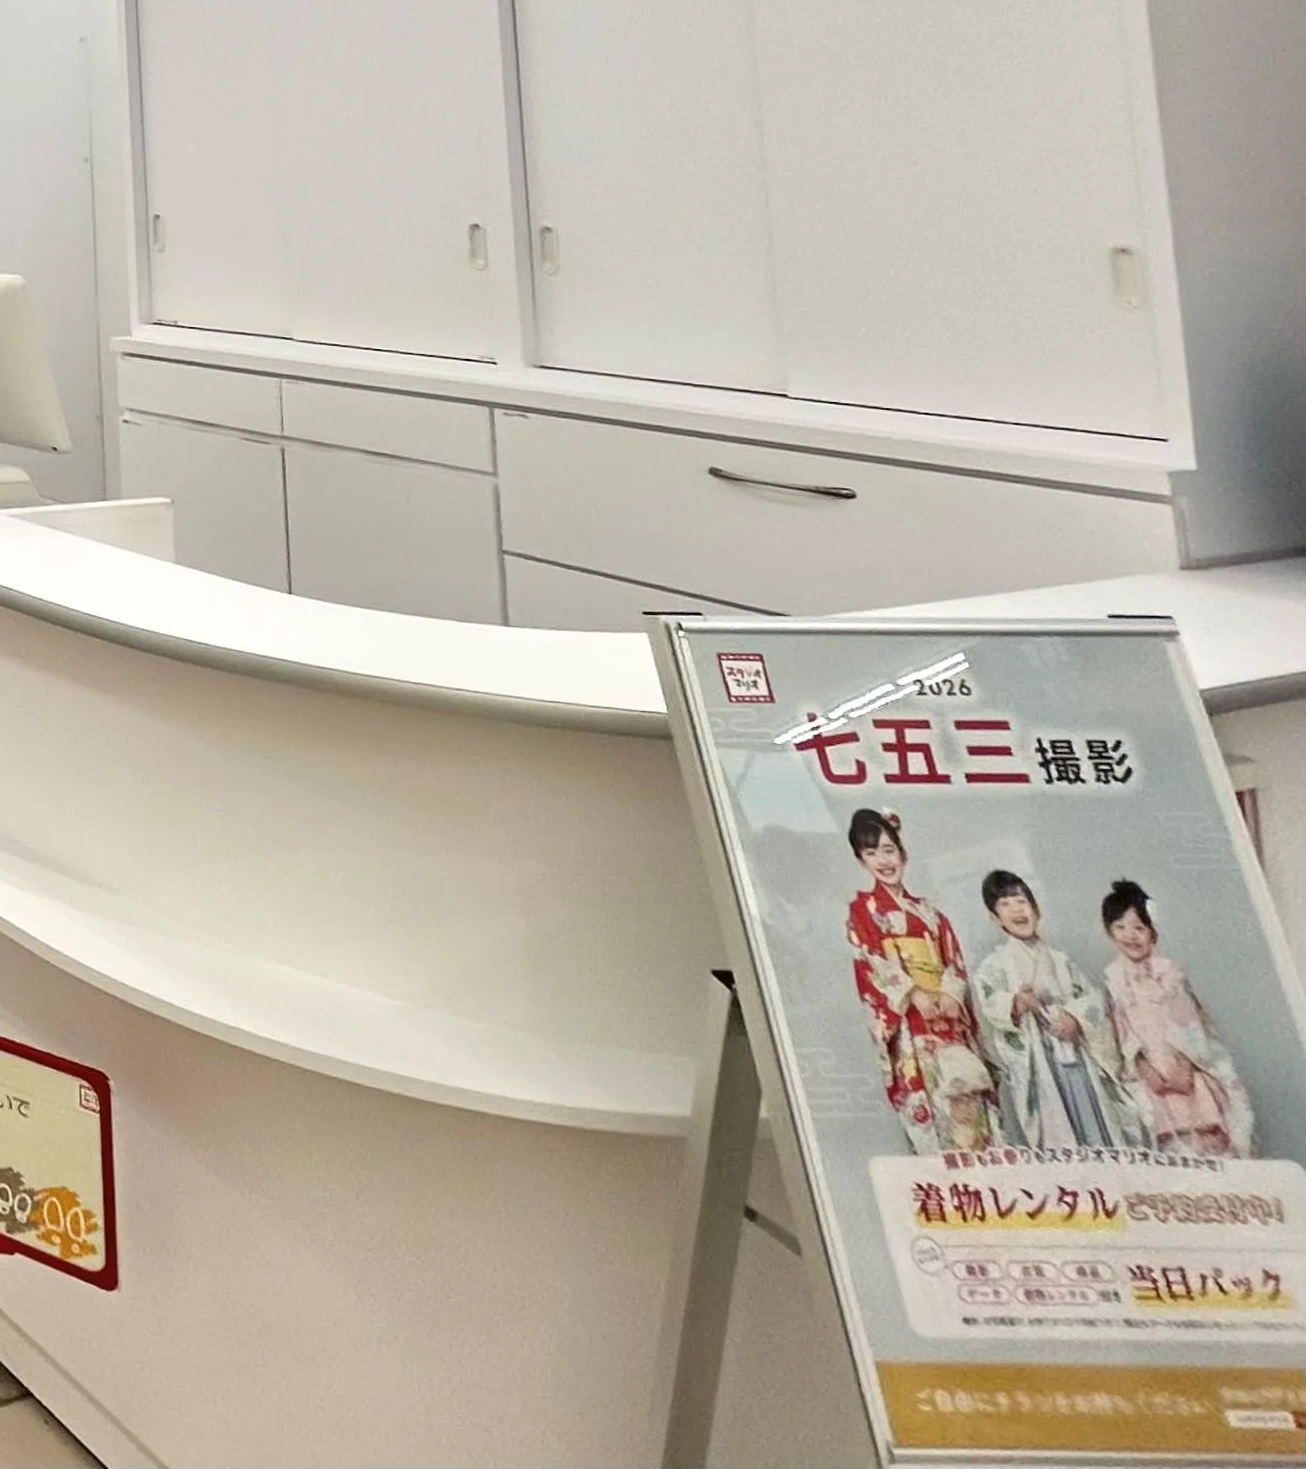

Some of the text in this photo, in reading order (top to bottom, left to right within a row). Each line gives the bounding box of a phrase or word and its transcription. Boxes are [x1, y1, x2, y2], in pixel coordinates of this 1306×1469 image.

[914, 678, 973, 696] 2026
[794, 712, 1134, 785] 七五三 撮影
[912, 1182, 1119, 1224] 着物レンタル
[1127, 1265, 1280, 1303] 当日パック
